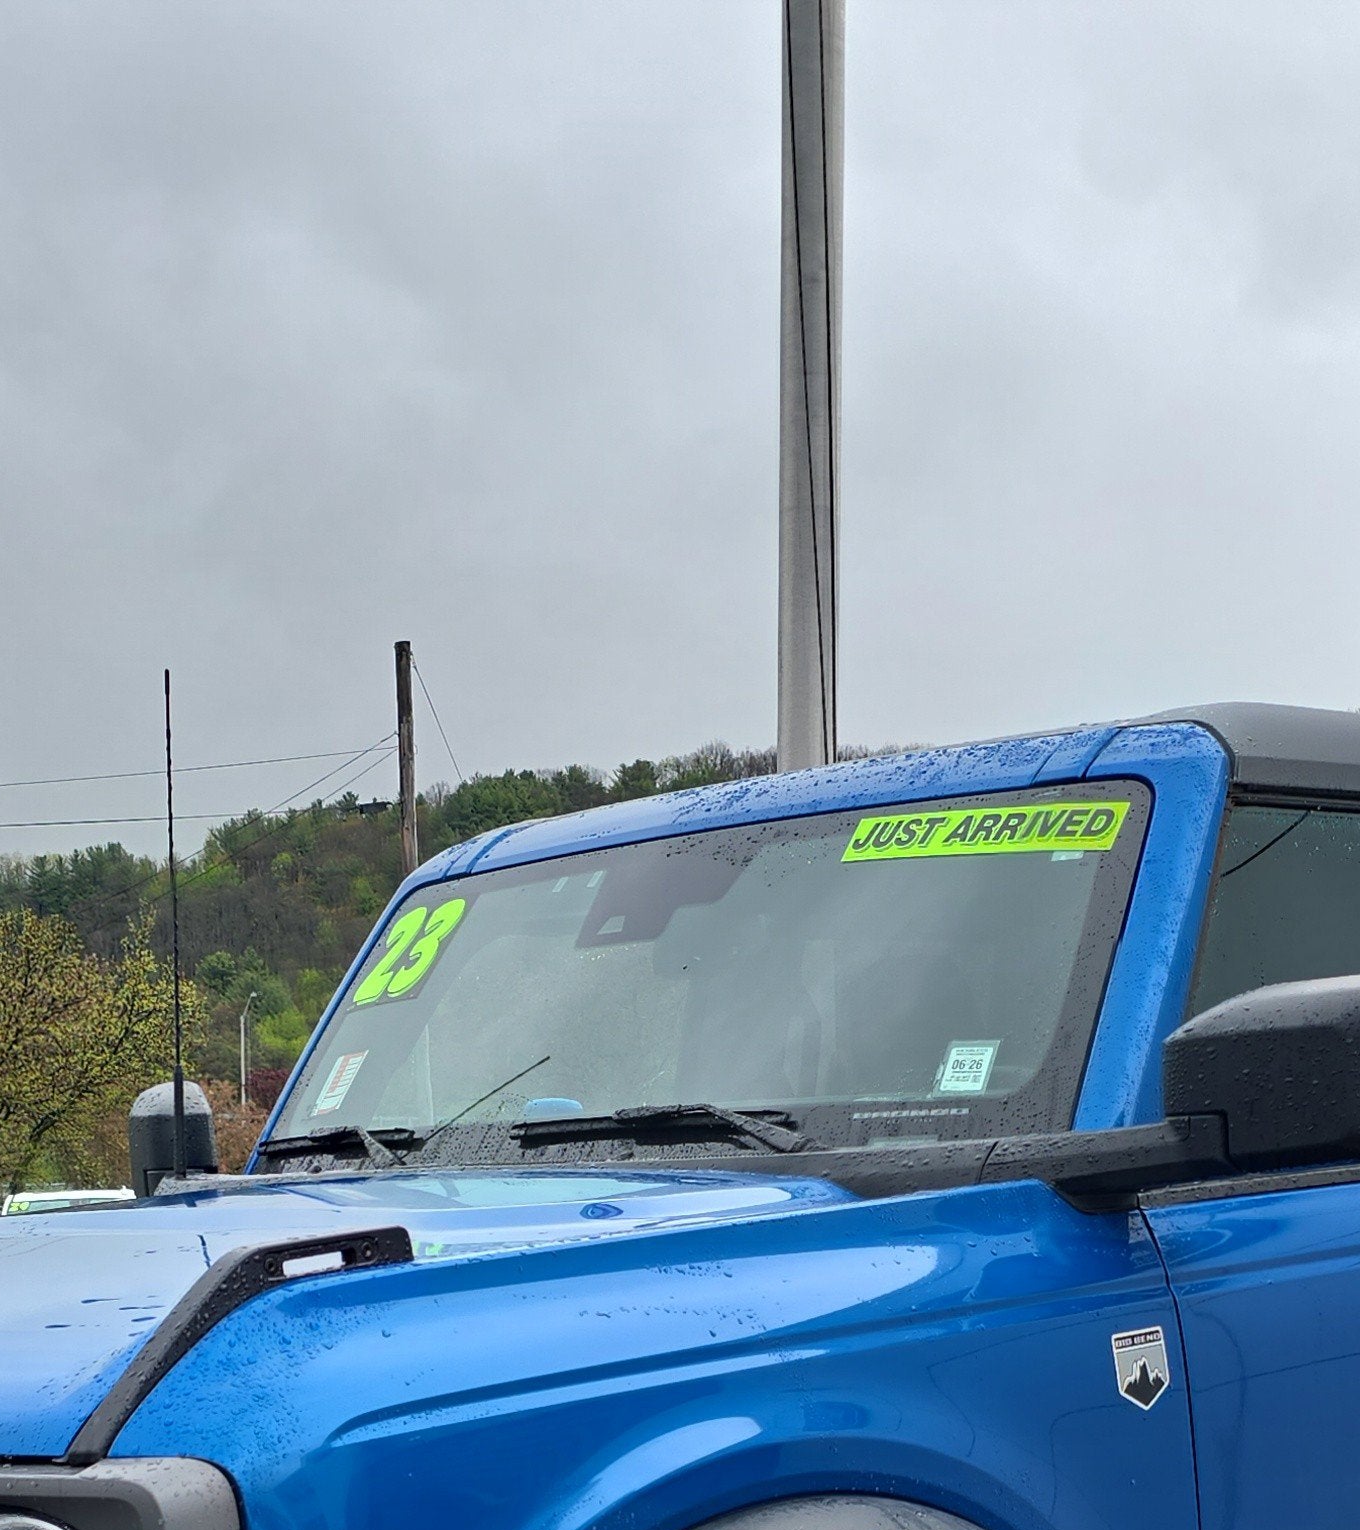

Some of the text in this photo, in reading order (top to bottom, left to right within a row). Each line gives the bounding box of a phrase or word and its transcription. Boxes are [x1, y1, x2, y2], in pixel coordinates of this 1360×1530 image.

[851, 807, 1118, 852] JUST ARRIVED
[353, 898, 466, 1006] 23
[951, 1059, 984, 1070] 06 26
